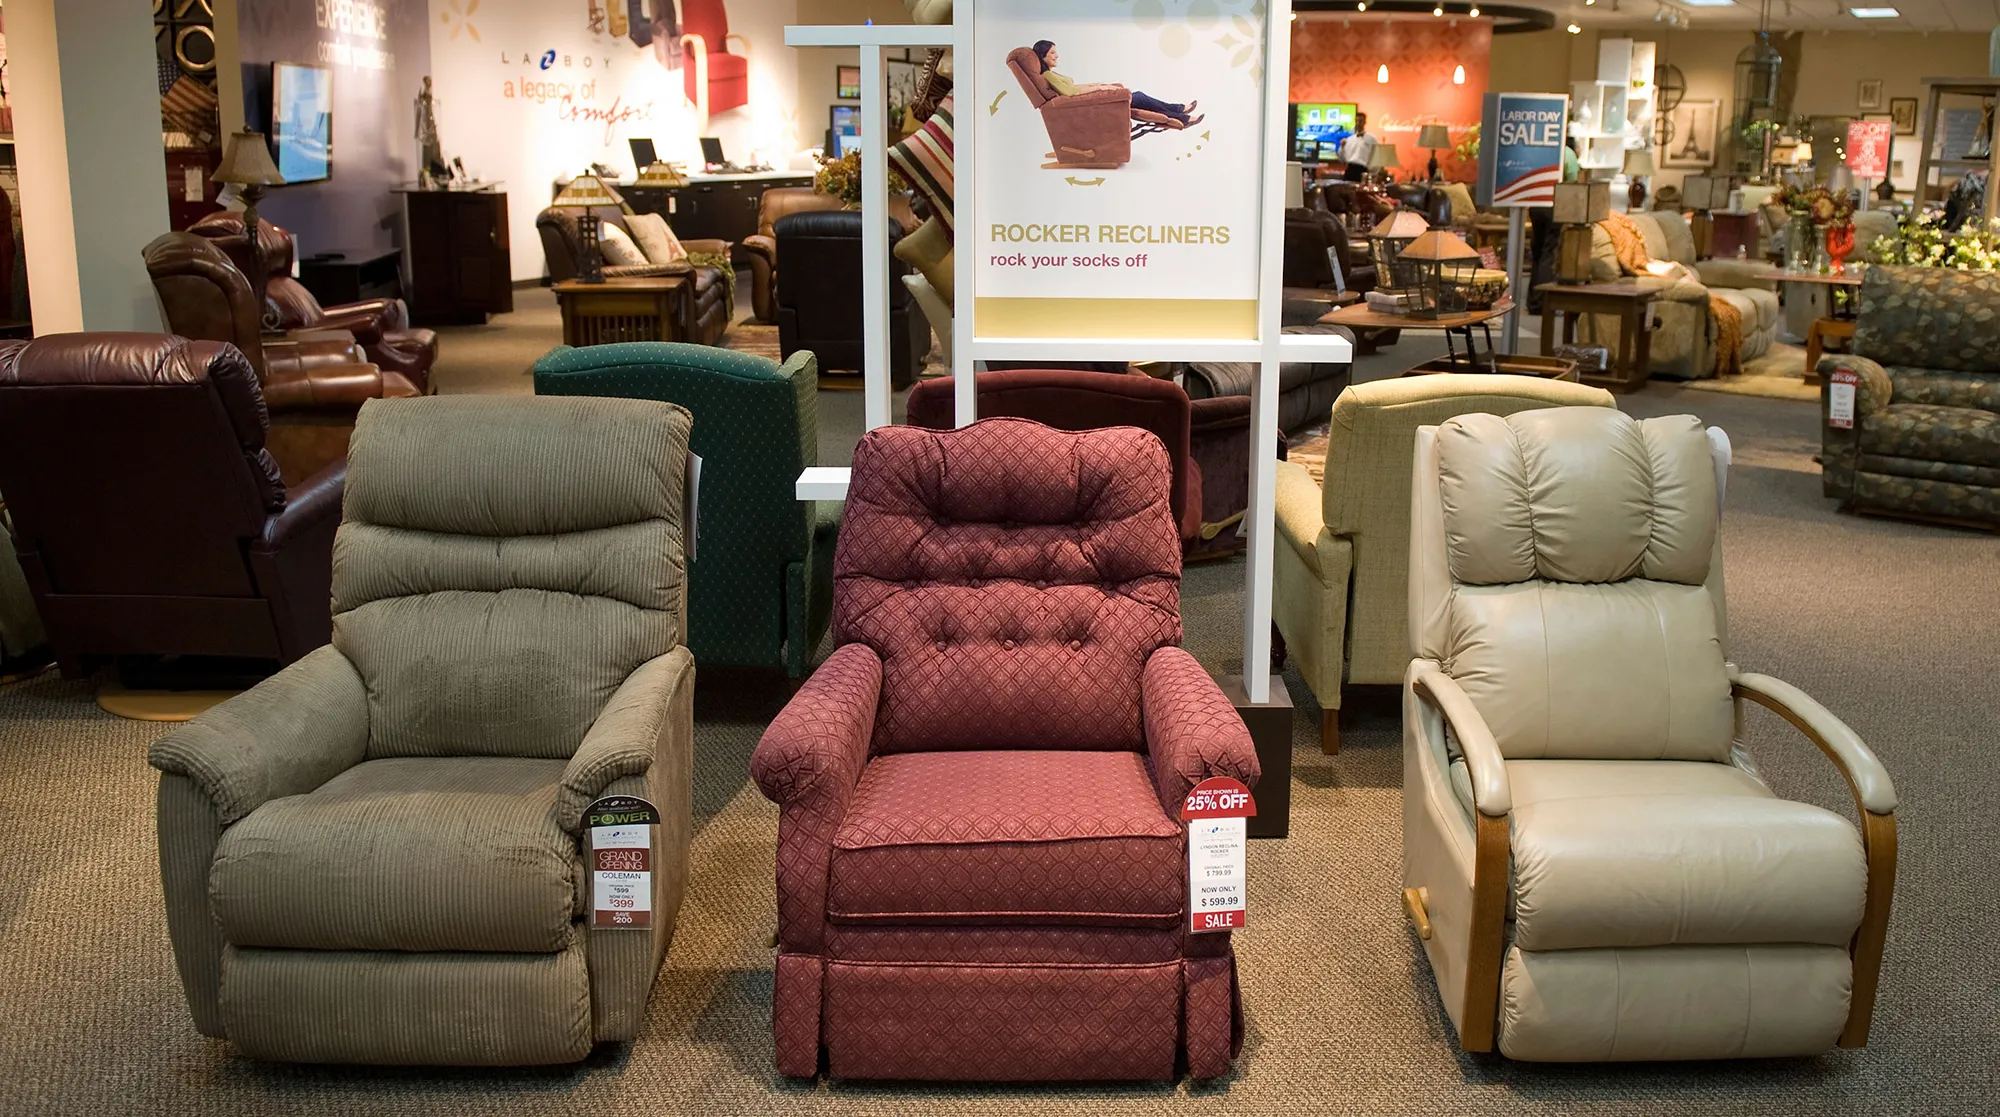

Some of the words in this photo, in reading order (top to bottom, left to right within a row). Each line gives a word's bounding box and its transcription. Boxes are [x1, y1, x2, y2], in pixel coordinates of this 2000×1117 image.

[503, 80, 515, 98] a
[520, 76, 575, 104] legacy
[581, 79, 596, 99] of
[558, 94, 655, 145] Comfort
[1503, 111, 1536, 121] LABOR
[1538, 111, 1561, 122] DAY
[1500, 122, 1560, 146] SALE
[991, 224, 1090, 243] ROCKER
[1098, 225, 1231, 245] RECLINERS
[990, 253, 1027, 267] rock
[1031, 255, 1068, 270] your
[1072, 253, 1120, 267] socks
[1125, 254, 1148, 267] off
[1187, 795, 1217, 811] 25%
[1219, 793, 1249, 810] OFF
[590, 811, 650, 825] POWER
[599, 851, 643, 861] GRAND
[609, 899, 635, 908] $399
[1201, 898, 1207, 907] $
[1209, 896, 1239, 906] 599.99
[613, 916, 633, 924] $200
[1205, 913, 1233, 928] SALE
